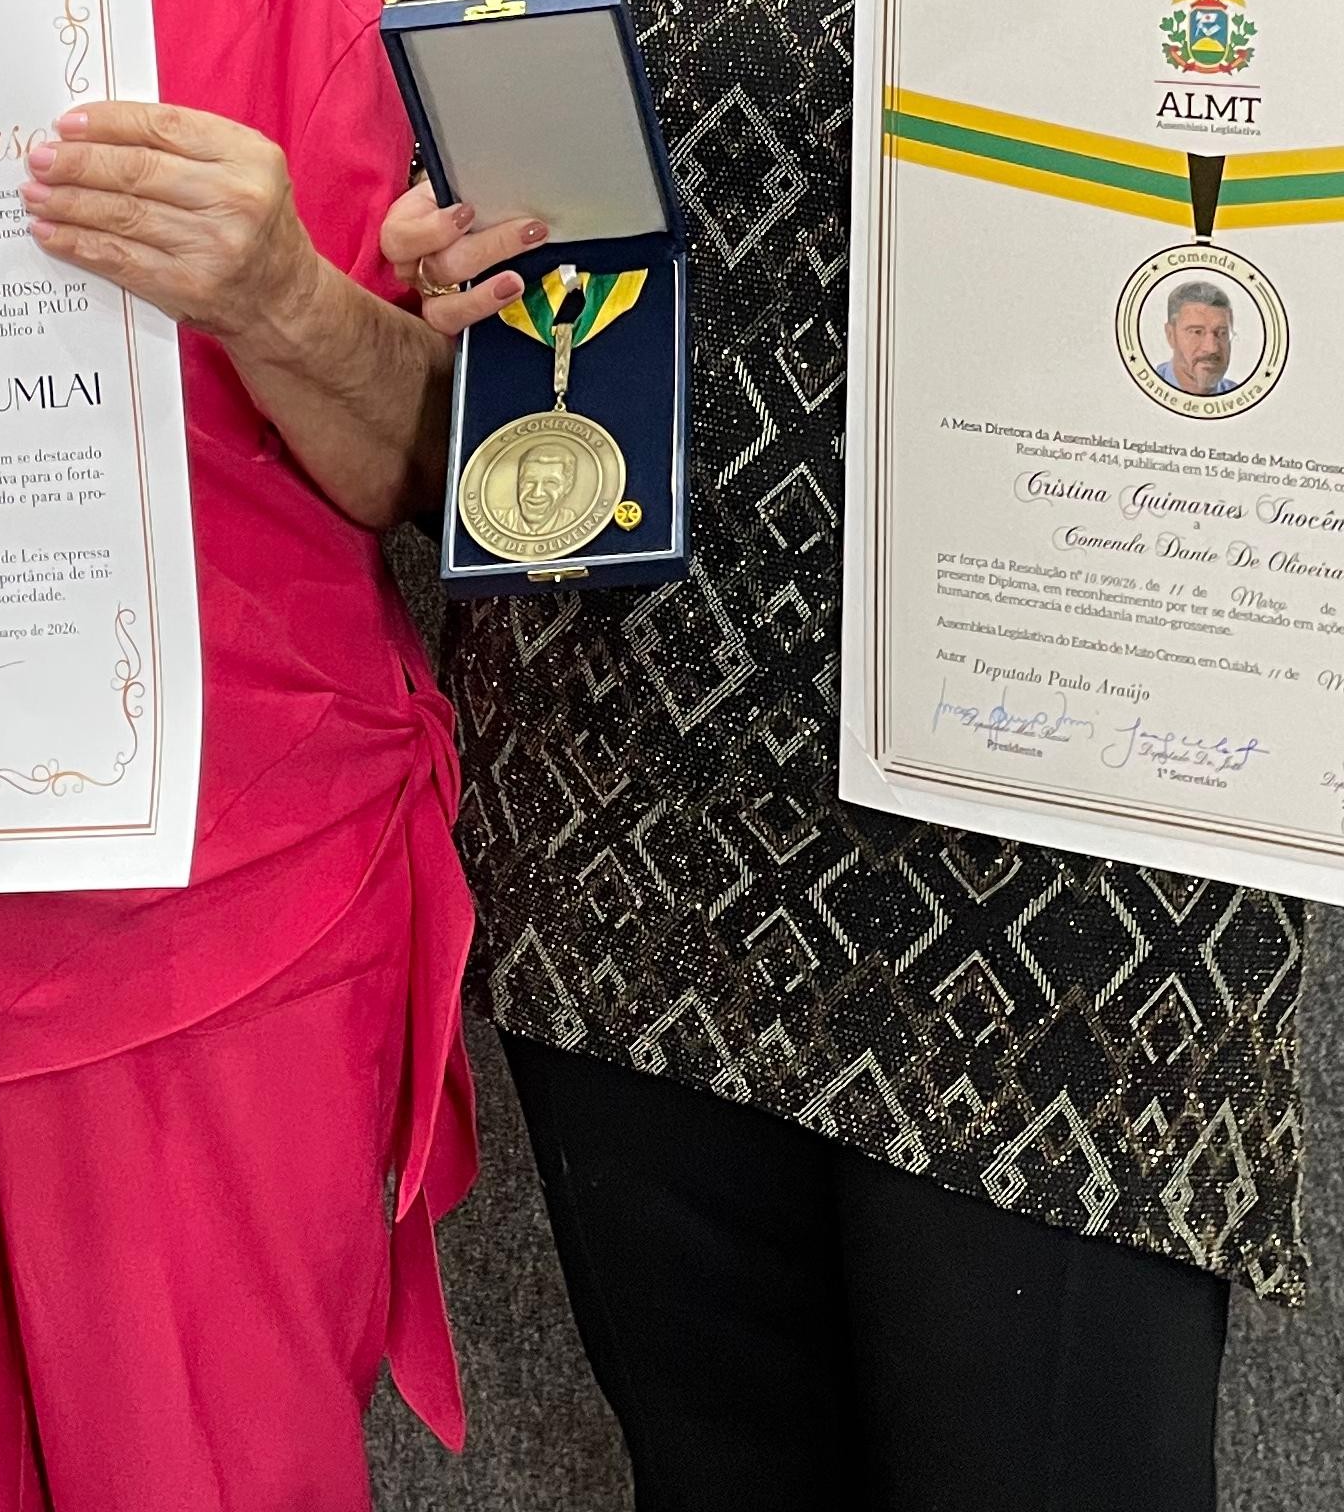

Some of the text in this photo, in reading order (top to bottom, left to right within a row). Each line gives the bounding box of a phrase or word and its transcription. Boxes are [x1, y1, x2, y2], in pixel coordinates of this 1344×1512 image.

[1156, 91, 1262, 123] ALMT
[1167, 253, 1236, 272] Comenda
[38, 298, 89, 315] PAULO
[1136, 368, 1263, 415] Dante de Oliveira
[516, 419, 592, 440] COMENDA
[34, 447, 102, 464] destacado
[952, 419, 982, 434] Mesa
[985, 422, 1032, 440] Diretora
[1123, 438, 1187, 457] Legislativa
[1209, 448, 1249, 464] Estado
[1269, 455, 1303, 470] Mato
[21, 474, 51, 489] para
[67, 469, 105, 482] forta-
[1014, 470, 1110, 506] Cristina
[1118, 482, 1245, 520] Guimarães
[467, 505, 605, 554] DANTE DE OLIVEIRA
[22, 549, 50, 563] Leis
[53, 549, 110, 565] expressa
[1052, 525, 1145, 554] Comenda
[1154, 532, 1218, 563] Dante
[1225, 540, 1260, 569] De
[972, 659, 1151, 704] Deputado Paulo Araújo
[987, 739, 1043, 758] Presidente
